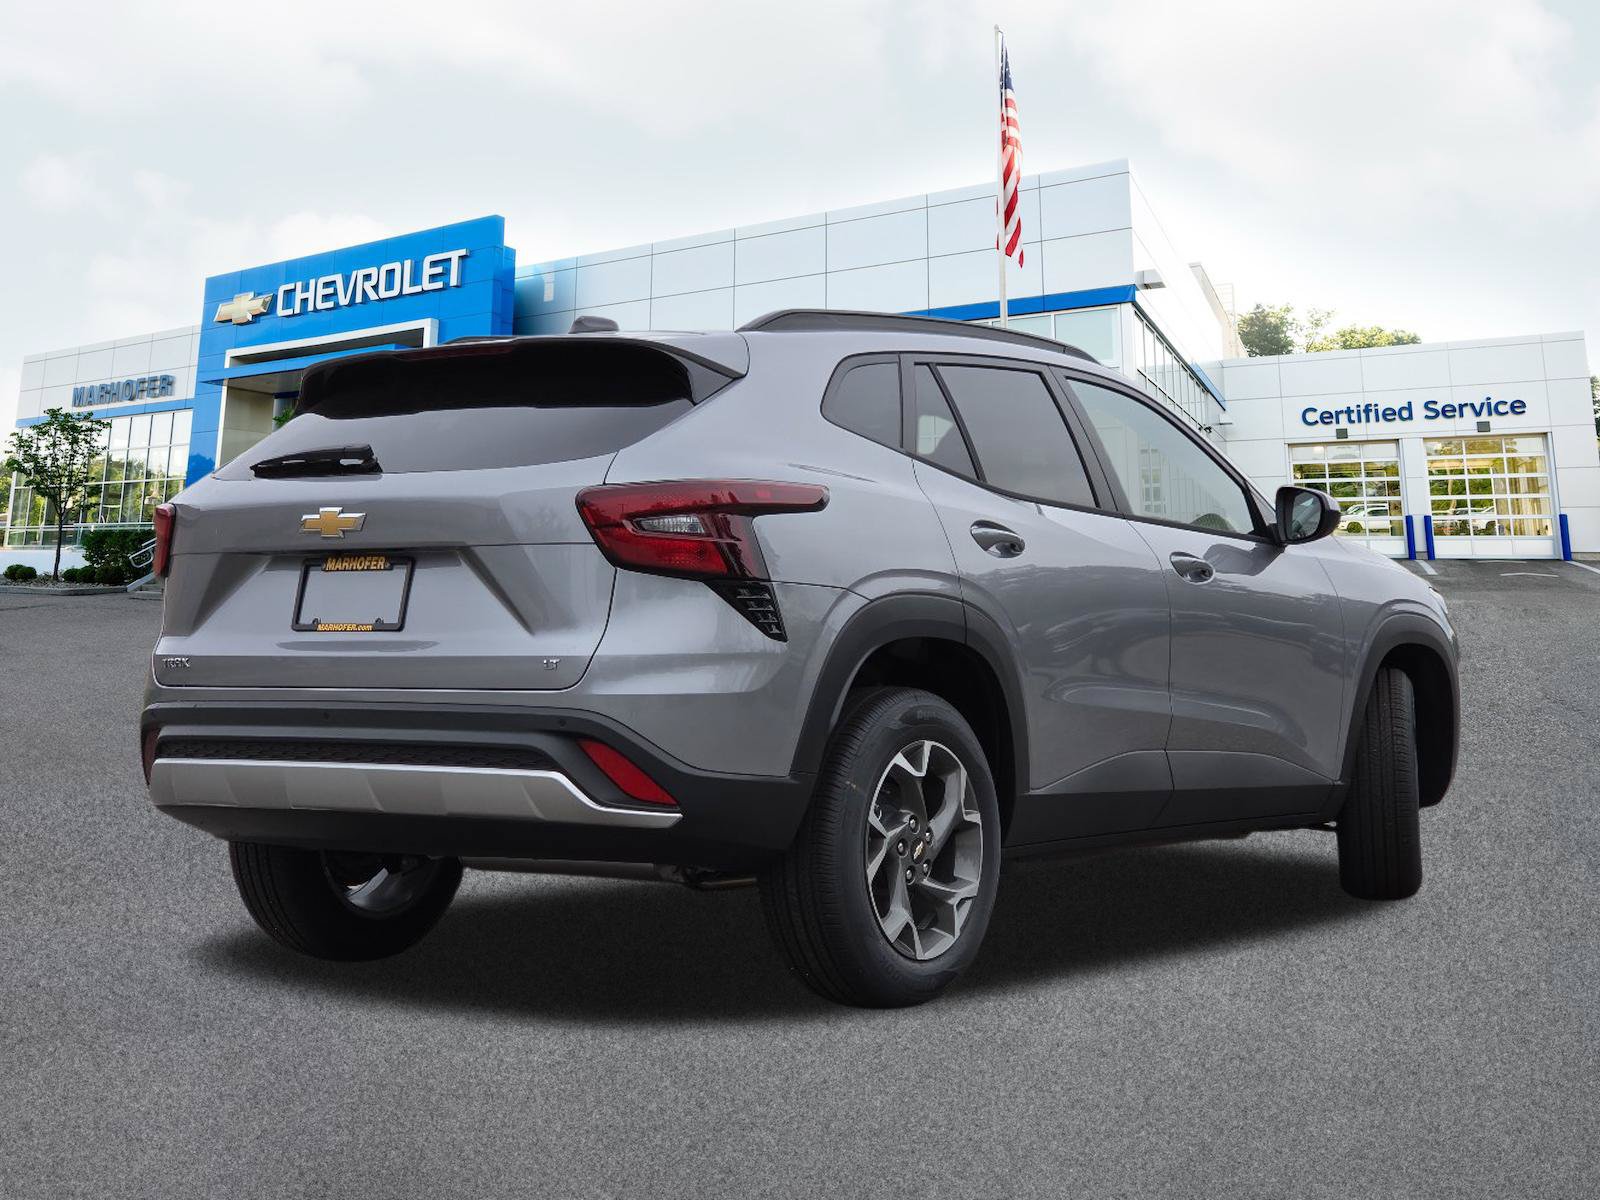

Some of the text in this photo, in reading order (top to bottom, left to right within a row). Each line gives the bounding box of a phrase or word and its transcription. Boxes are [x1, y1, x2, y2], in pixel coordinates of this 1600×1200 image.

[277, 248, 469, 317] CHEVROLET
[72, 374, 175, 407] MARHOFER
[1301, 396, 1528, 426] Certified Service
[325, 556, 386, 571] MARHOFER
